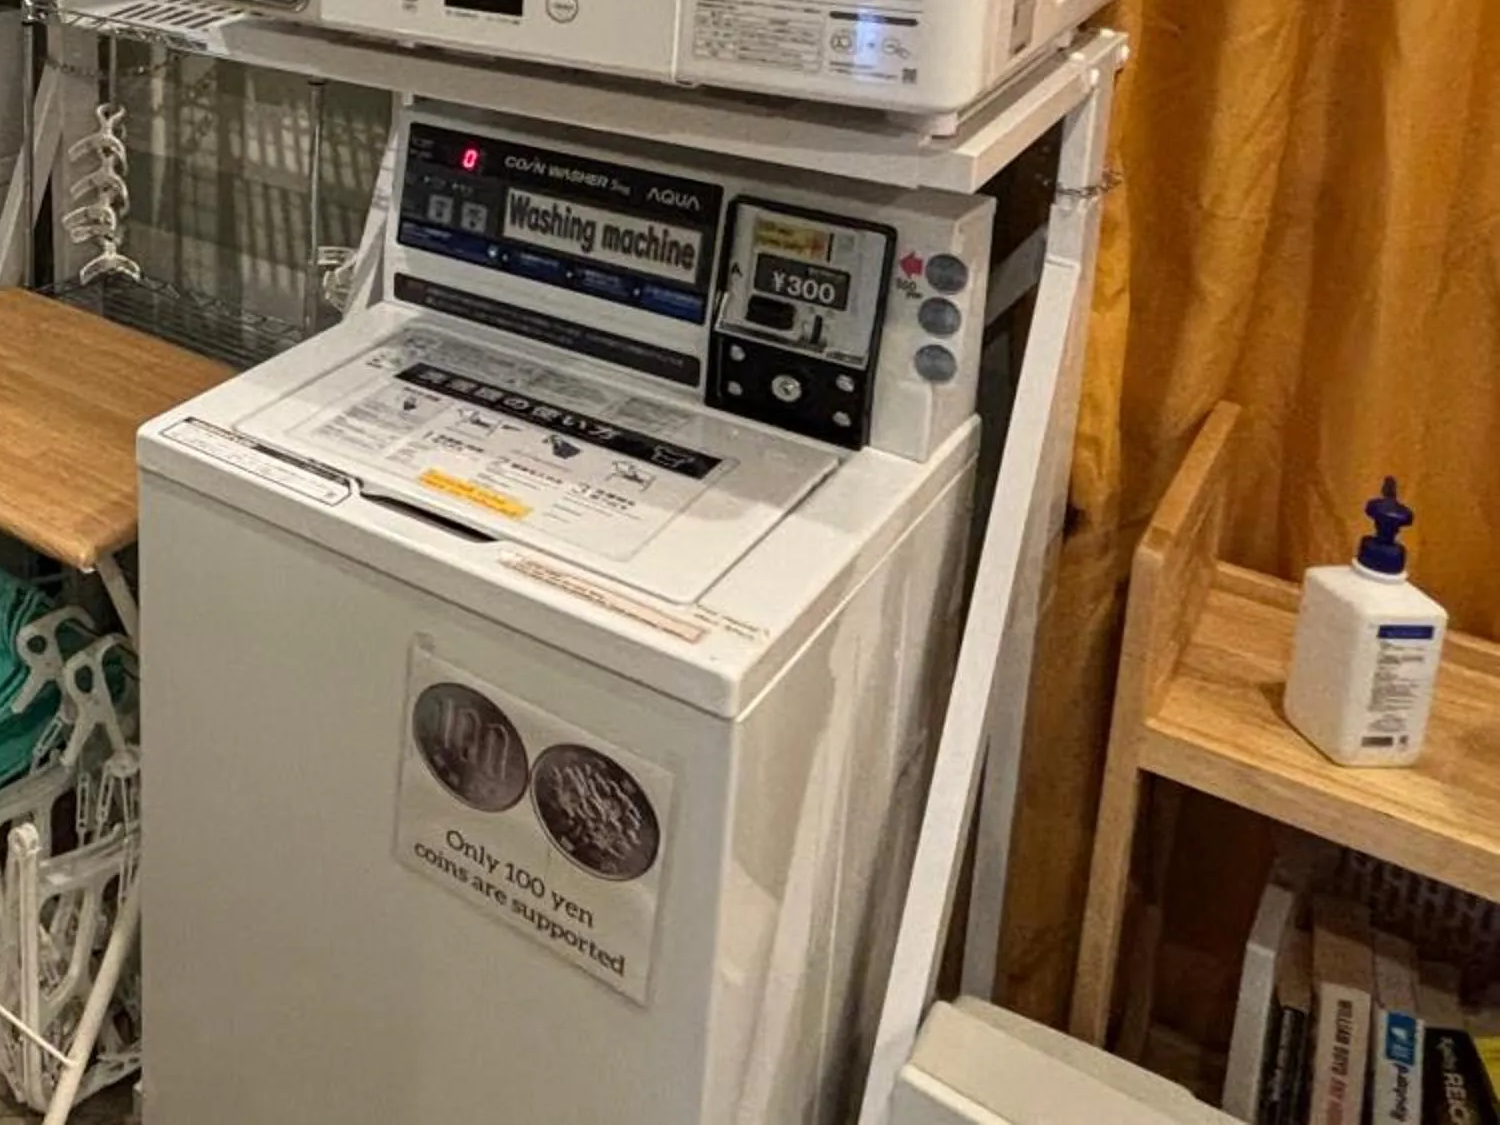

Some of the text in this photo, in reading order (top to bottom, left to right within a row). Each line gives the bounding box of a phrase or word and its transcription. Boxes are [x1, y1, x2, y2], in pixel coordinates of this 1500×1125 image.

[462, 149, 480, 170] 0
[547, 165, 610, 188] WASHER
[646, 187, 700, 212] AQUA
[509, 192, 597, 254] Washing
[601, 222, 696, 271] machine
[771, 269, 836, 305] ¥300
[414, 841, 626, 978] coins are supported
[446, 829, 595, 929] Only 100 yen
